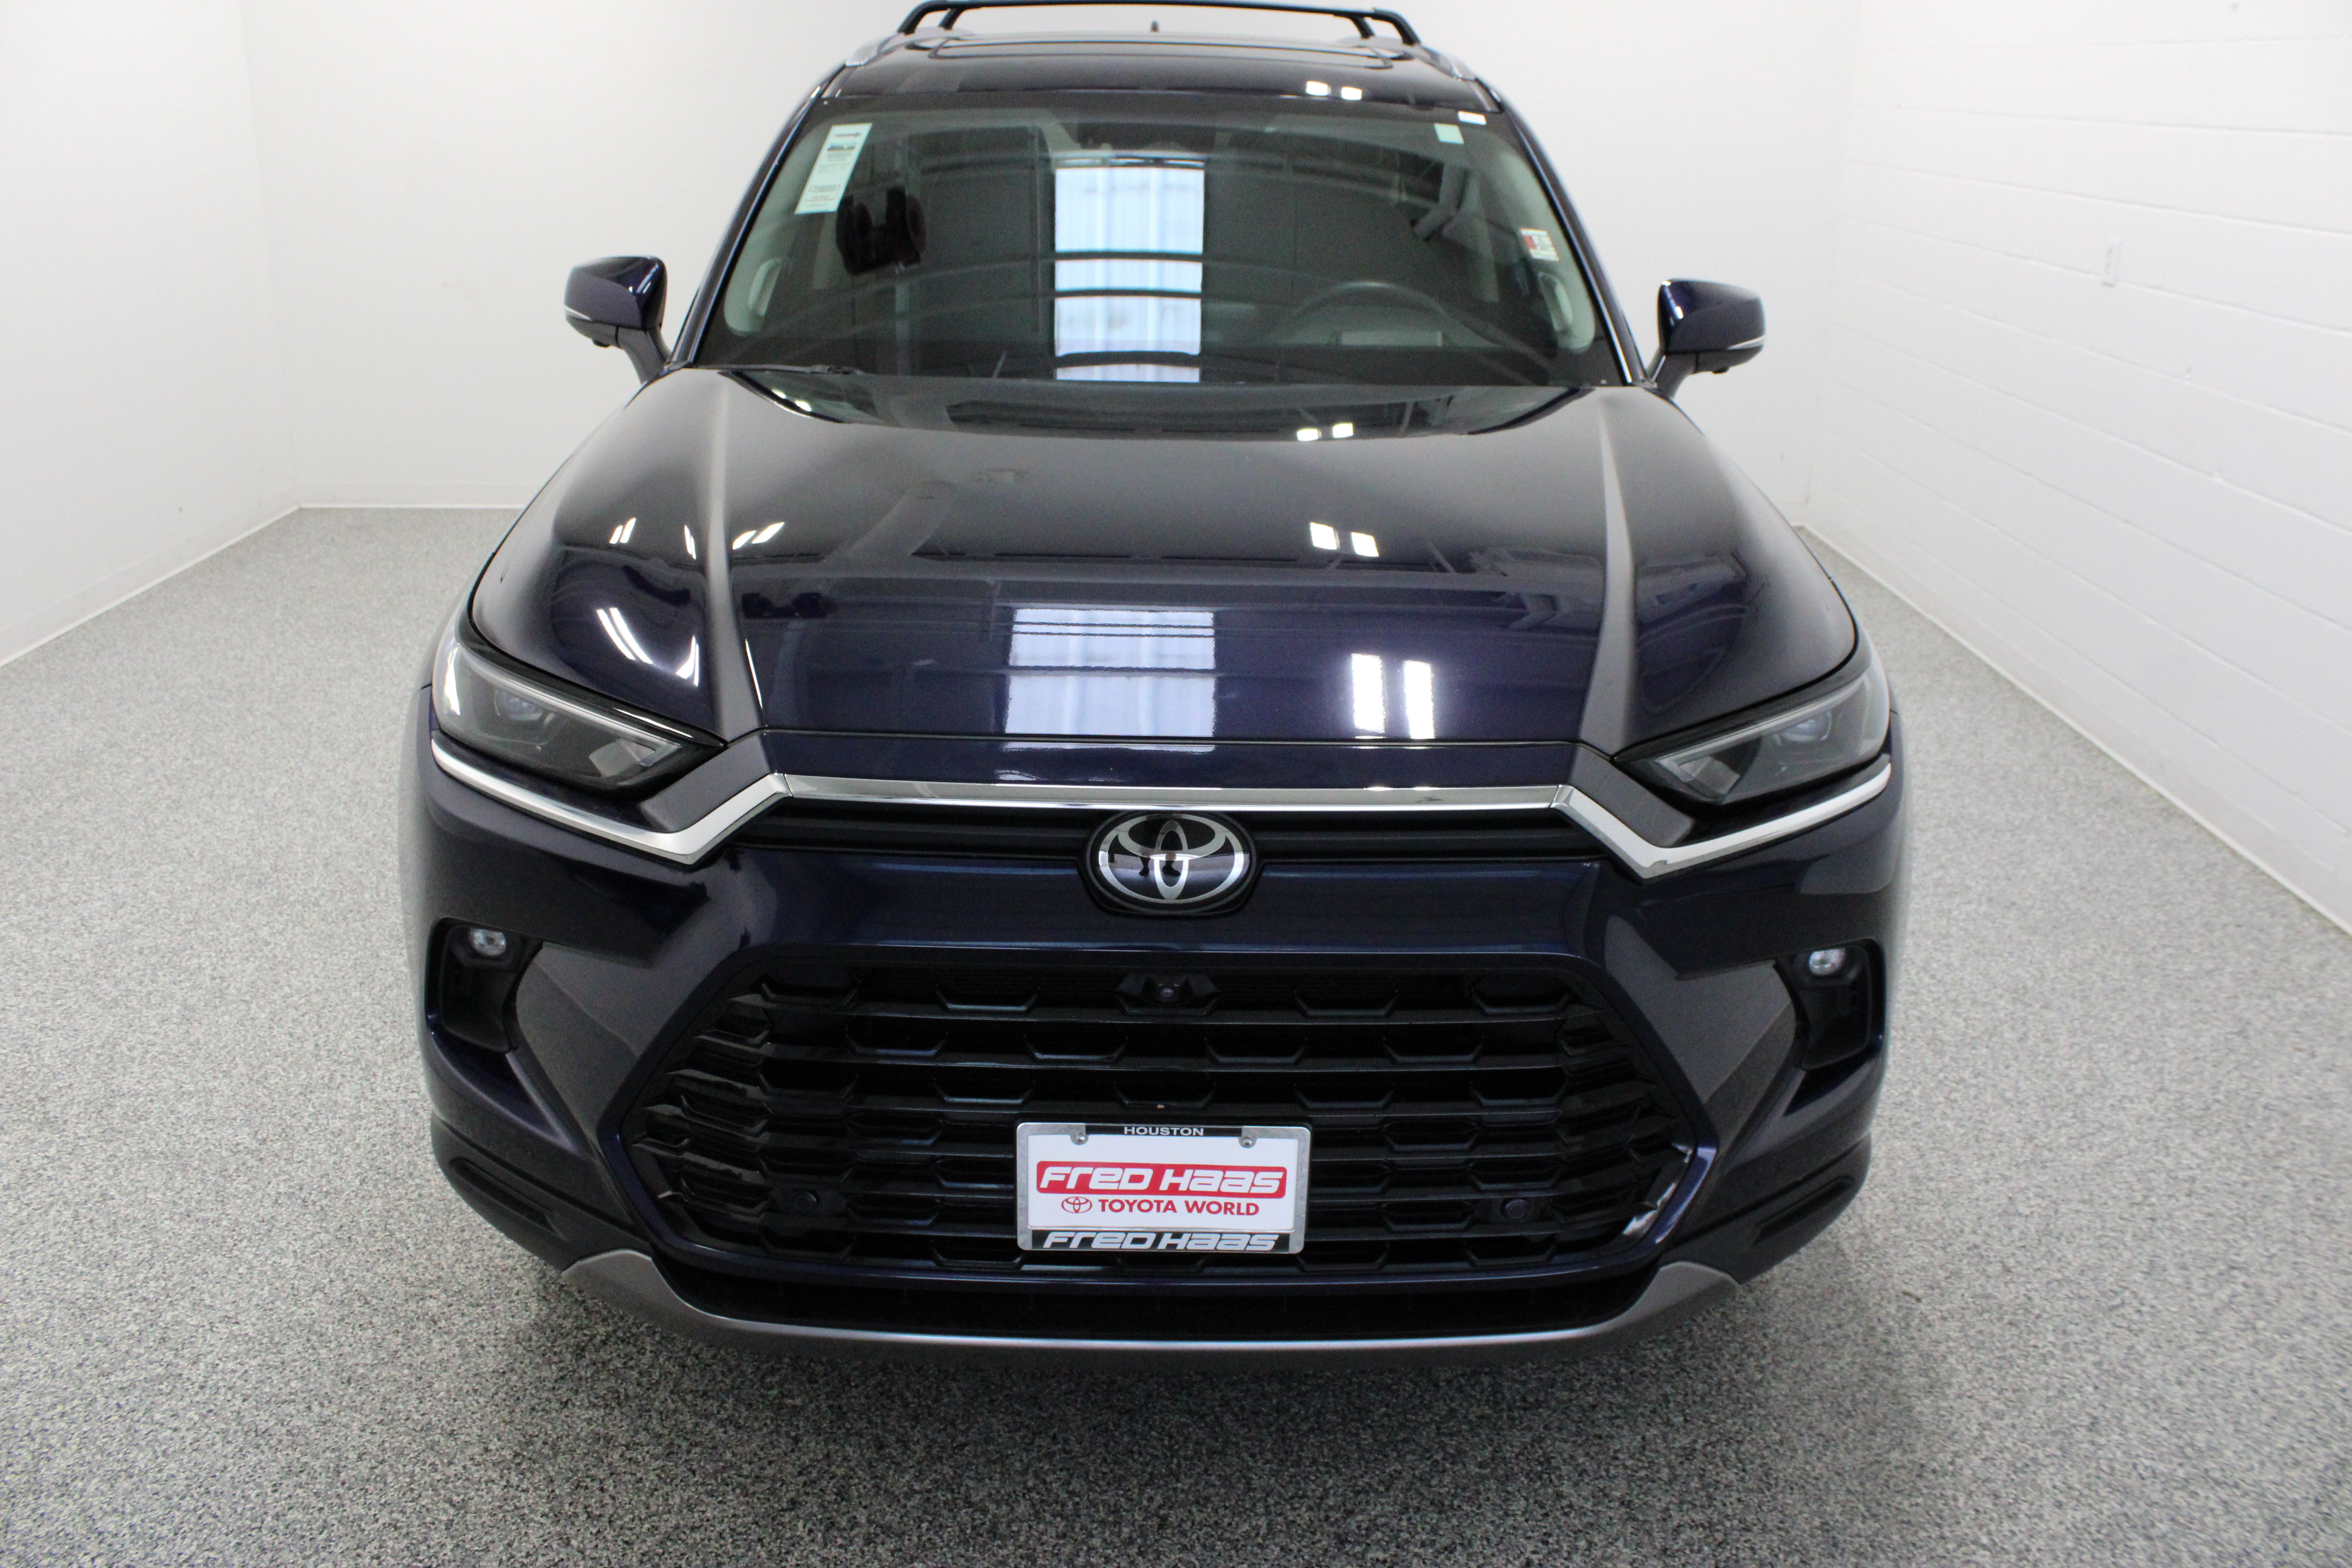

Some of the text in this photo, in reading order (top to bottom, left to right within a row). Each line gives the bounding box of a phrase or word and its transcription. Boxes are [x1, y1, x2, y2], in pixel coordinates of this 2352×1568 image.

[1124, 1126, 1204, 1136] HOUSTON
[1098, 1198, 1260, 1216] TOYOTA WORLD
